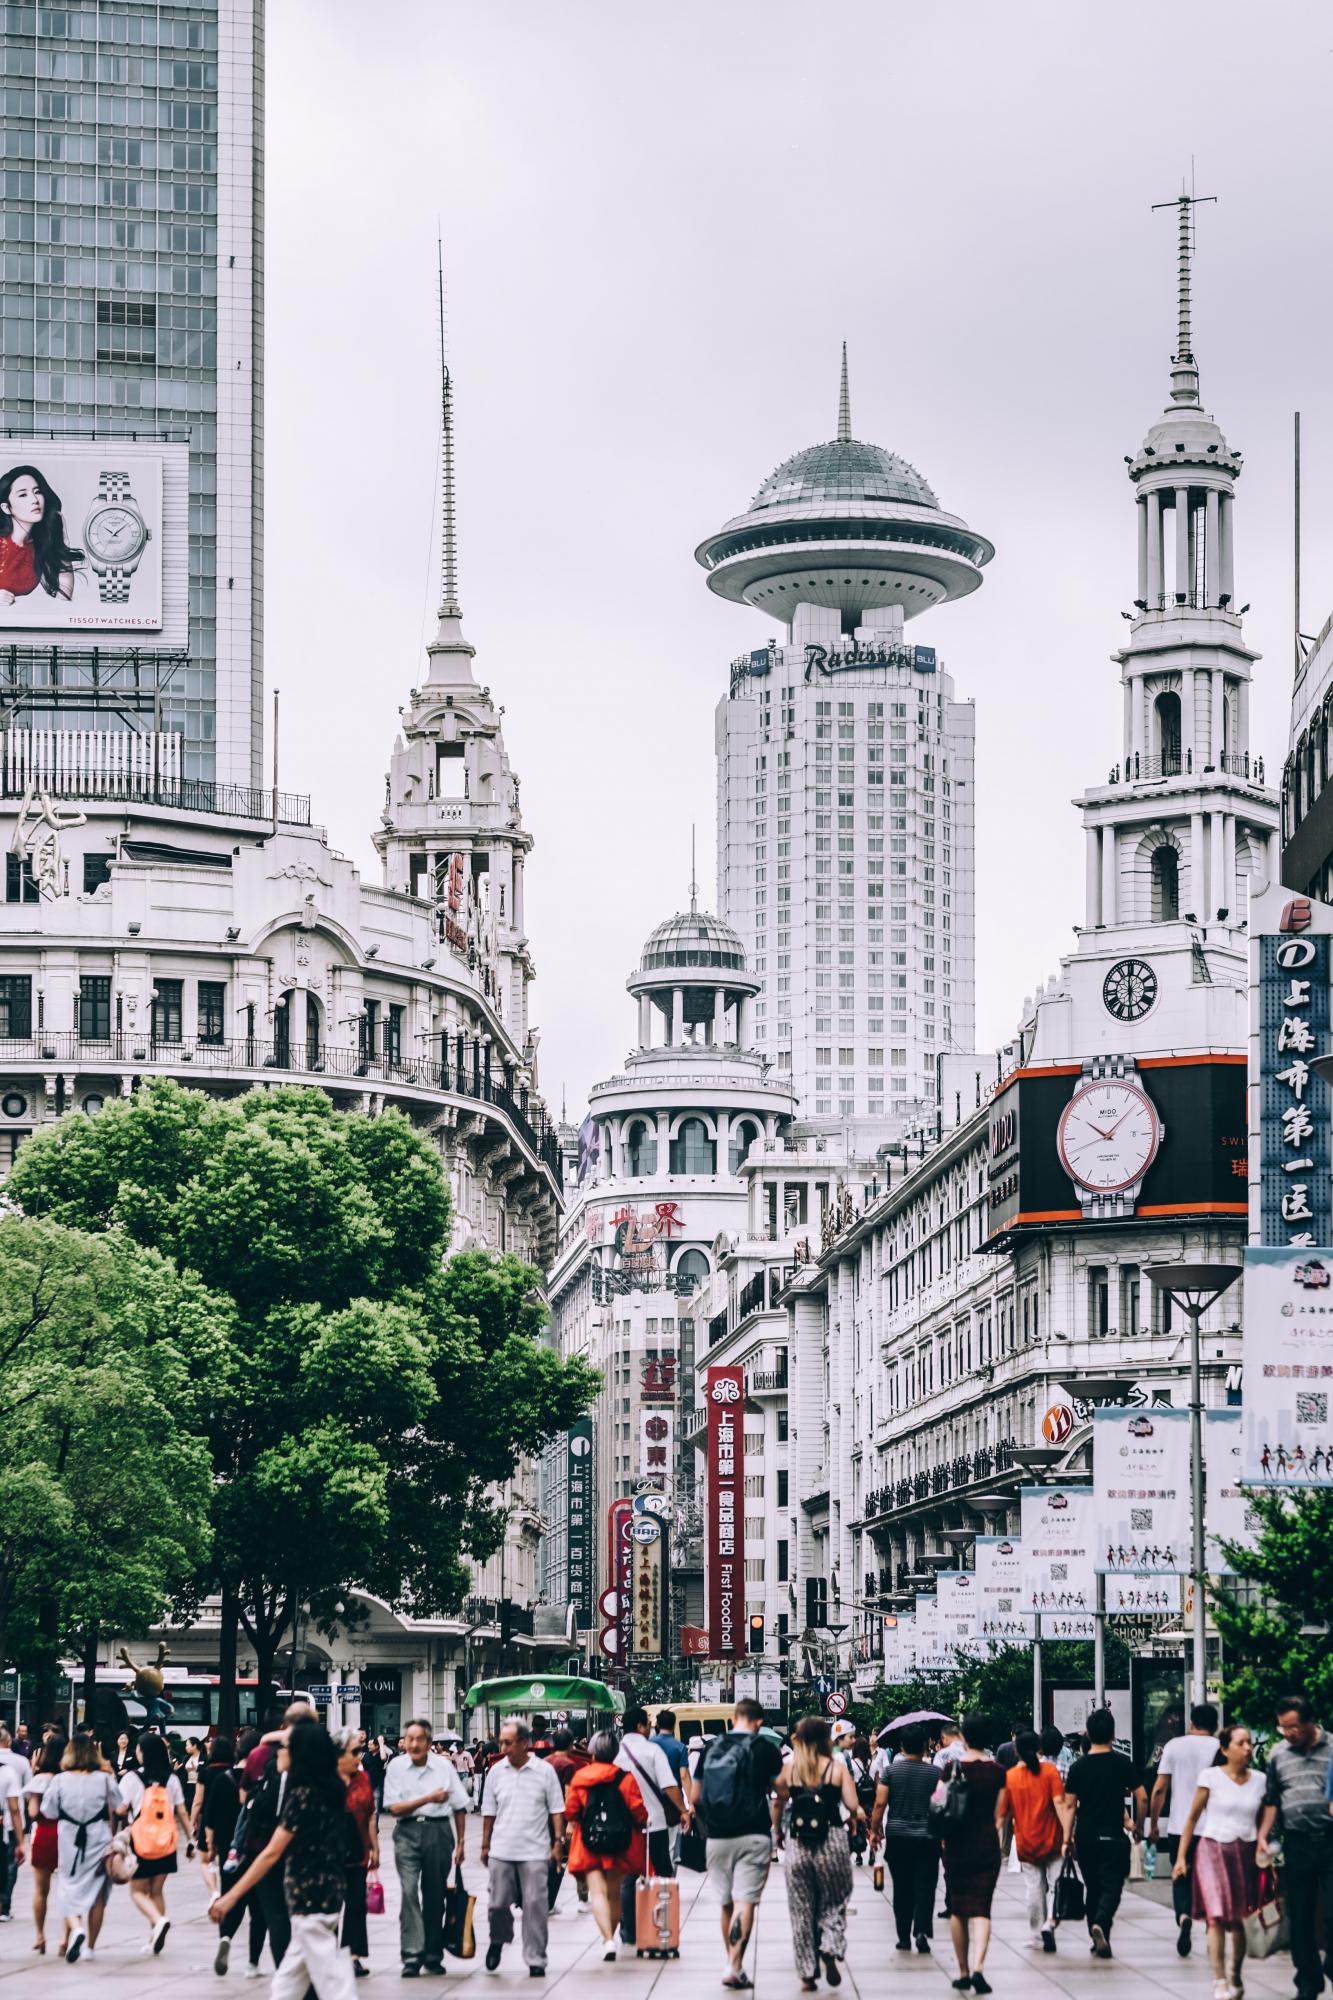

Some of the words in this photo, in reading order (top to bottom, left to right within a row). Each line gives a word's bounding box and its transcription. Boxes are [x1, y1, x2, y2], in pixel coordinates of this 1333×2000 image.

[69, 617, 158, 625] TISSOTWATCHES.CN
[751, 658, 767, 668] BLU
[804, 636, 912, 682] Radisson
[916, 655, 935, 665] BLU
[991, 1110, 1014, 1158] MIDO
[718, 1411, 735, 1555] 上海市第一食品商店
[570, 1463, 583, 1611] 上海市第一百货商店
[721, 1564, 733, 1589] First
[721, 1592, 734, 1649] Foodhall
